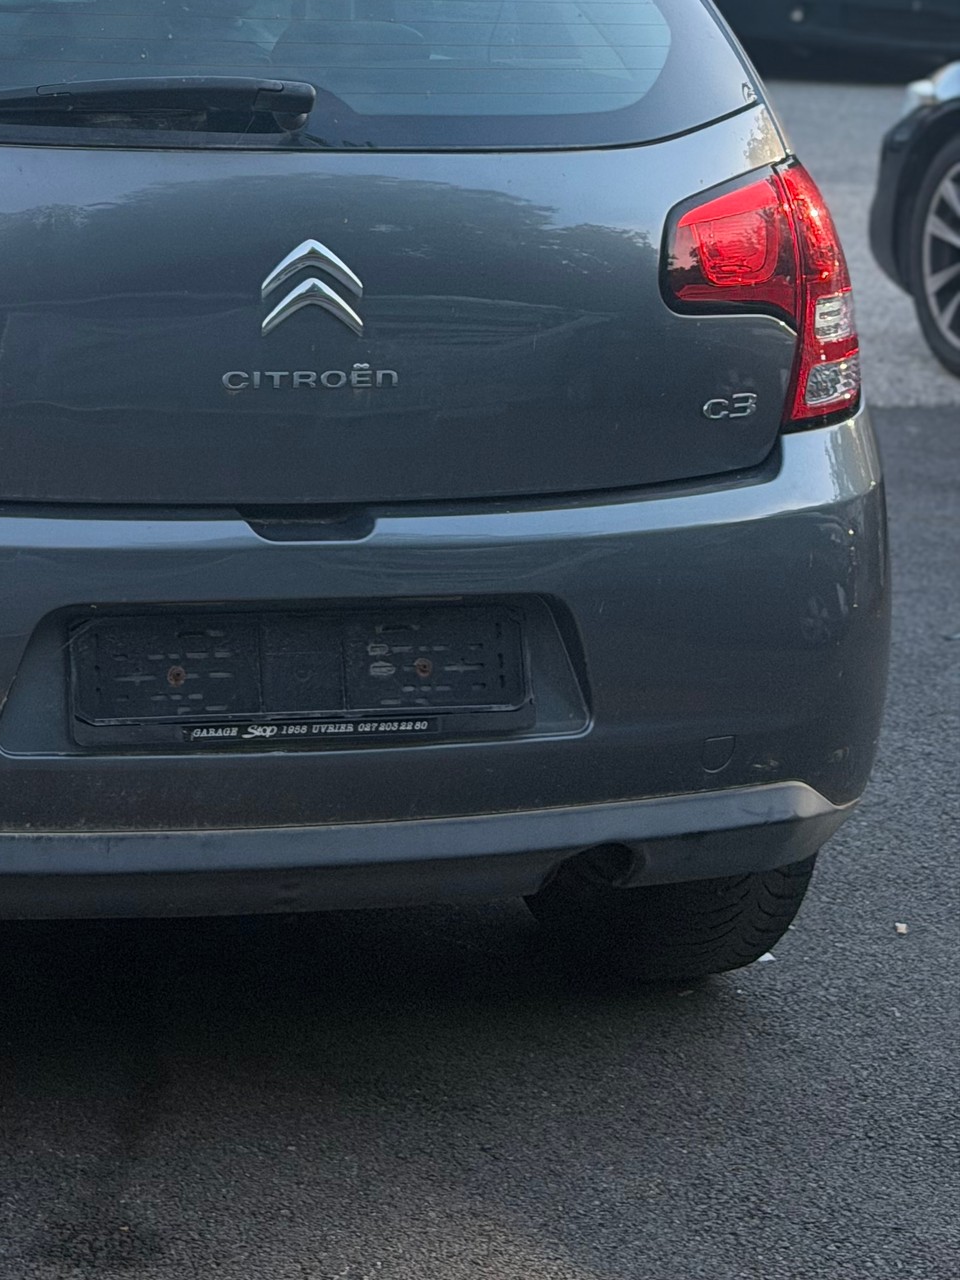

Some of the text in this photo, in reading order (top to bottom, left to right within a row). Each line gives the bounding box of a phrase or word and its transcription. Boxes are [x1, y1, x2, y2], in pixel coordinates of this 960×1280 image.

[702, 392, 758, 419] C3
[192, 727, 239, 738] GARAGE
[241, 724, 278, 739] Stop
[311, 723, 355, 734] UVRIER
